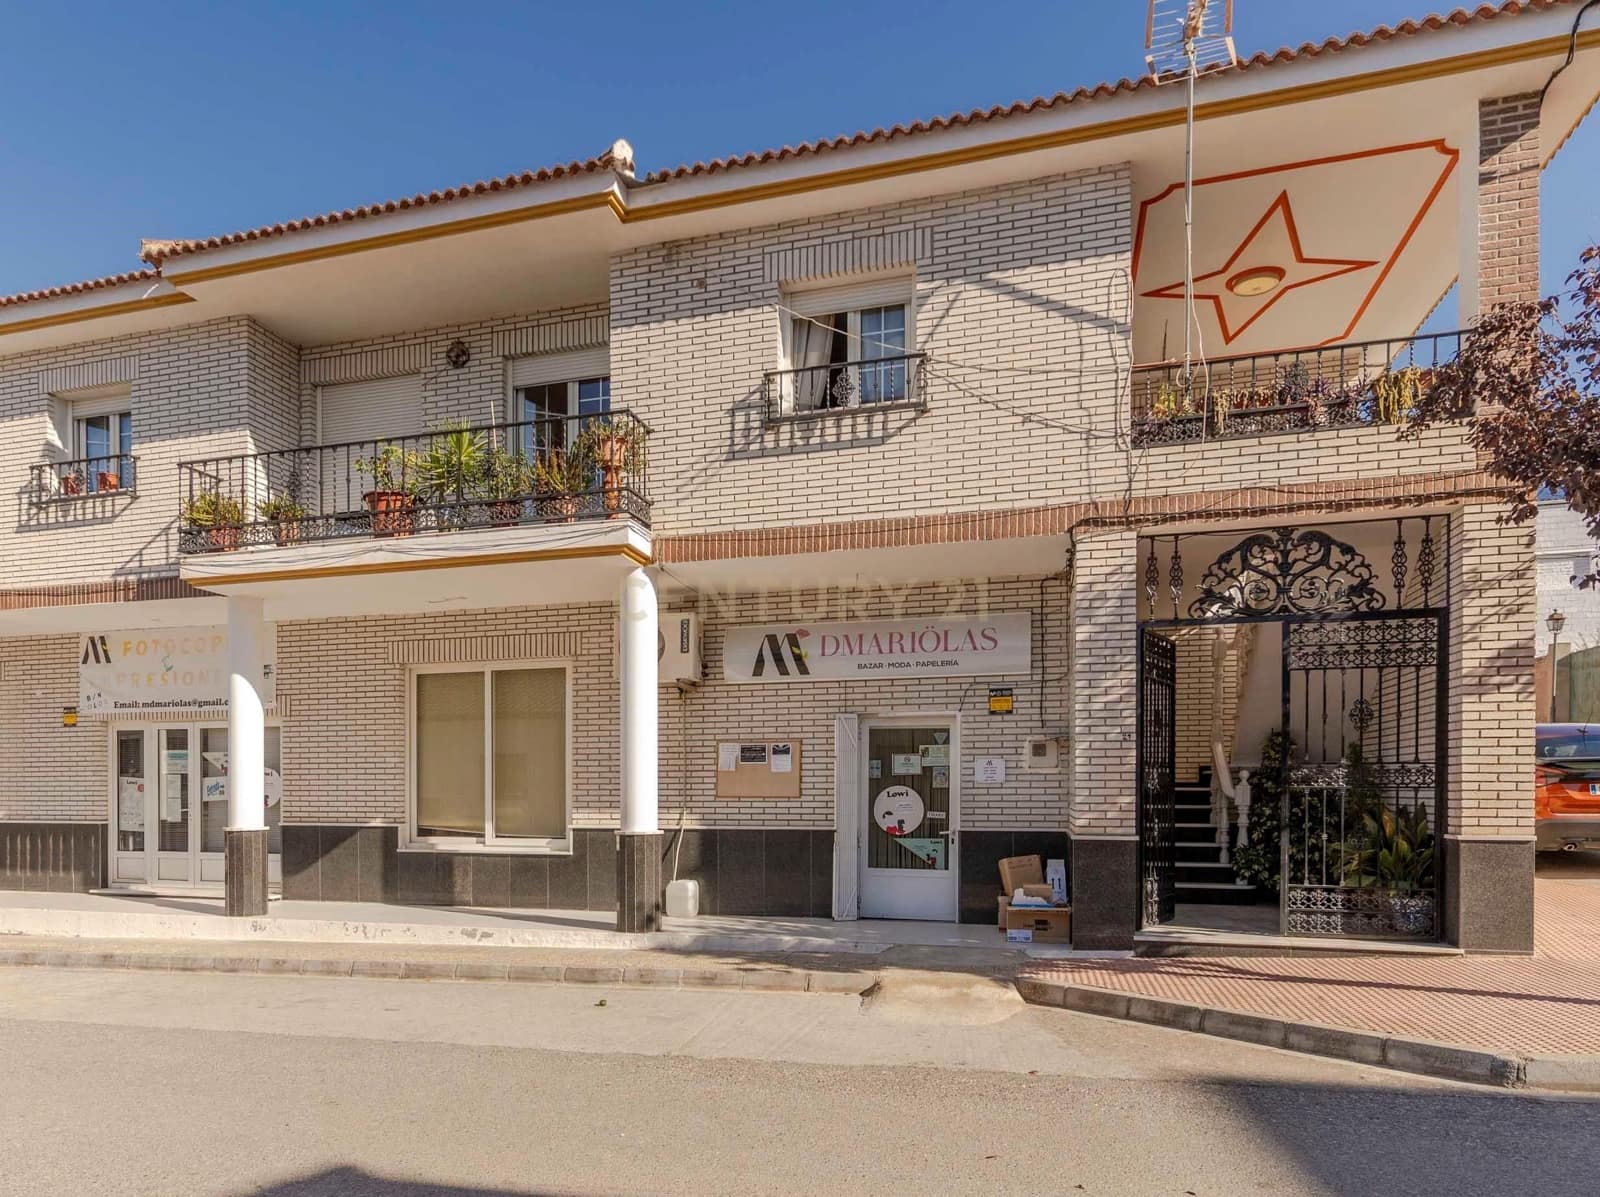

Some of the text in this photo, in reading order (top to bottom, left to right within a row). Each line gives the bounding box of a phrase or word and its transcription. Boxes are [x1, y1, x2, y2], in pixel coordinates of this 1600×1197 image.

[122, 635, 227, 656] FOTOCOP
[820, 625, 999, 657] DMARIÖLAS
[857, 659, 959, 670] BAZAR MODA PAPELERÍA
[114, 698, 229, 709] Email: mdmariolas@gmail.c
[886, 789, 909, 798] Lowi
